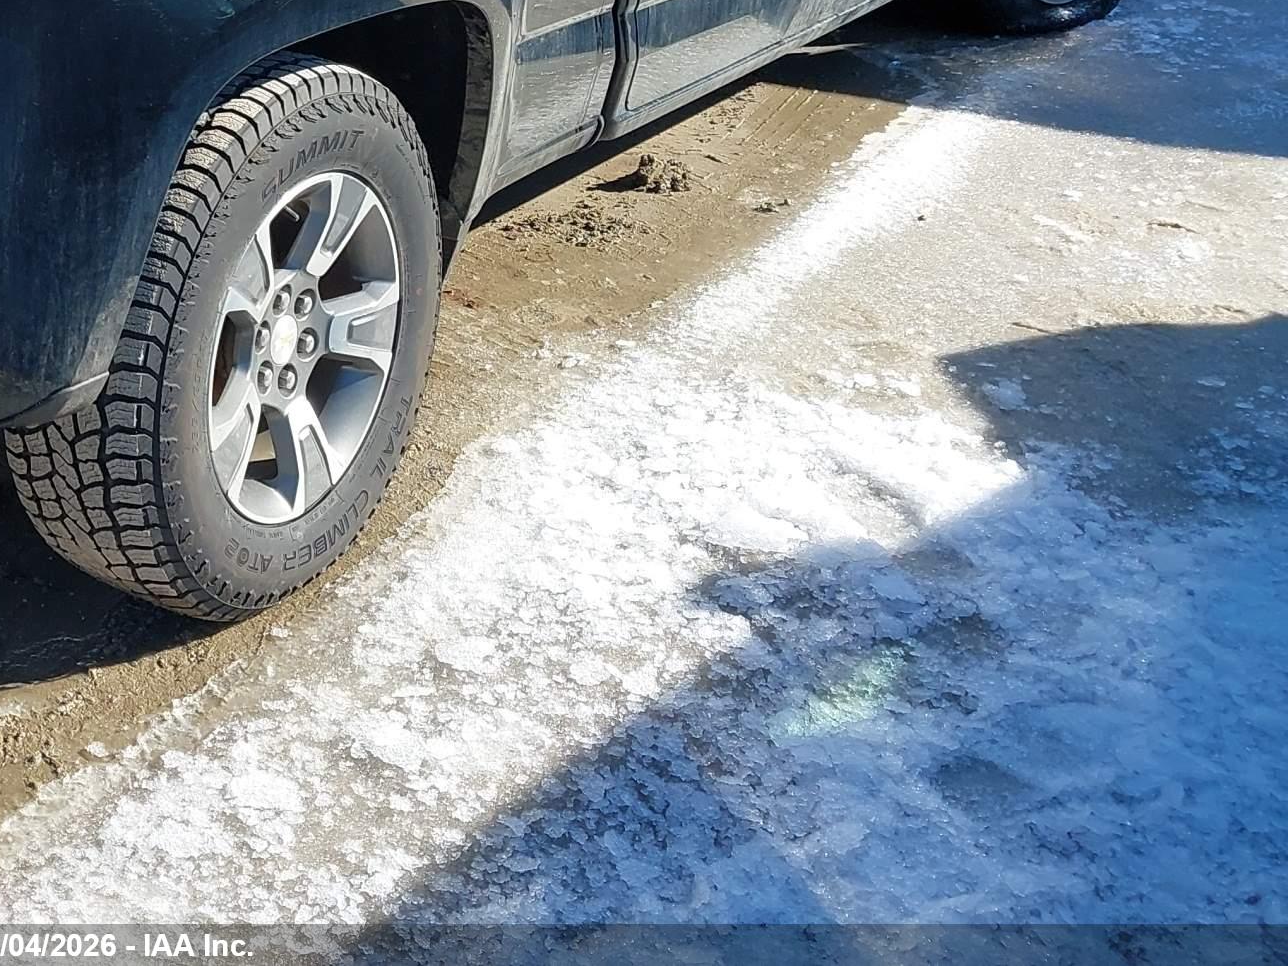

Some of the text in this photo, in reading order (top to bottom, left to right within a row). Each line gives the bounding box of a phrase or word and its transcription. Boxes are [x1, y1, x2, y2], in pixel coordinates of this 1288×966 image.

[262, 129, 366, 202] SUMMIT
[369, 395, 414, 479] TRAIL
[283, 488, 370, 572] CLIMBER
